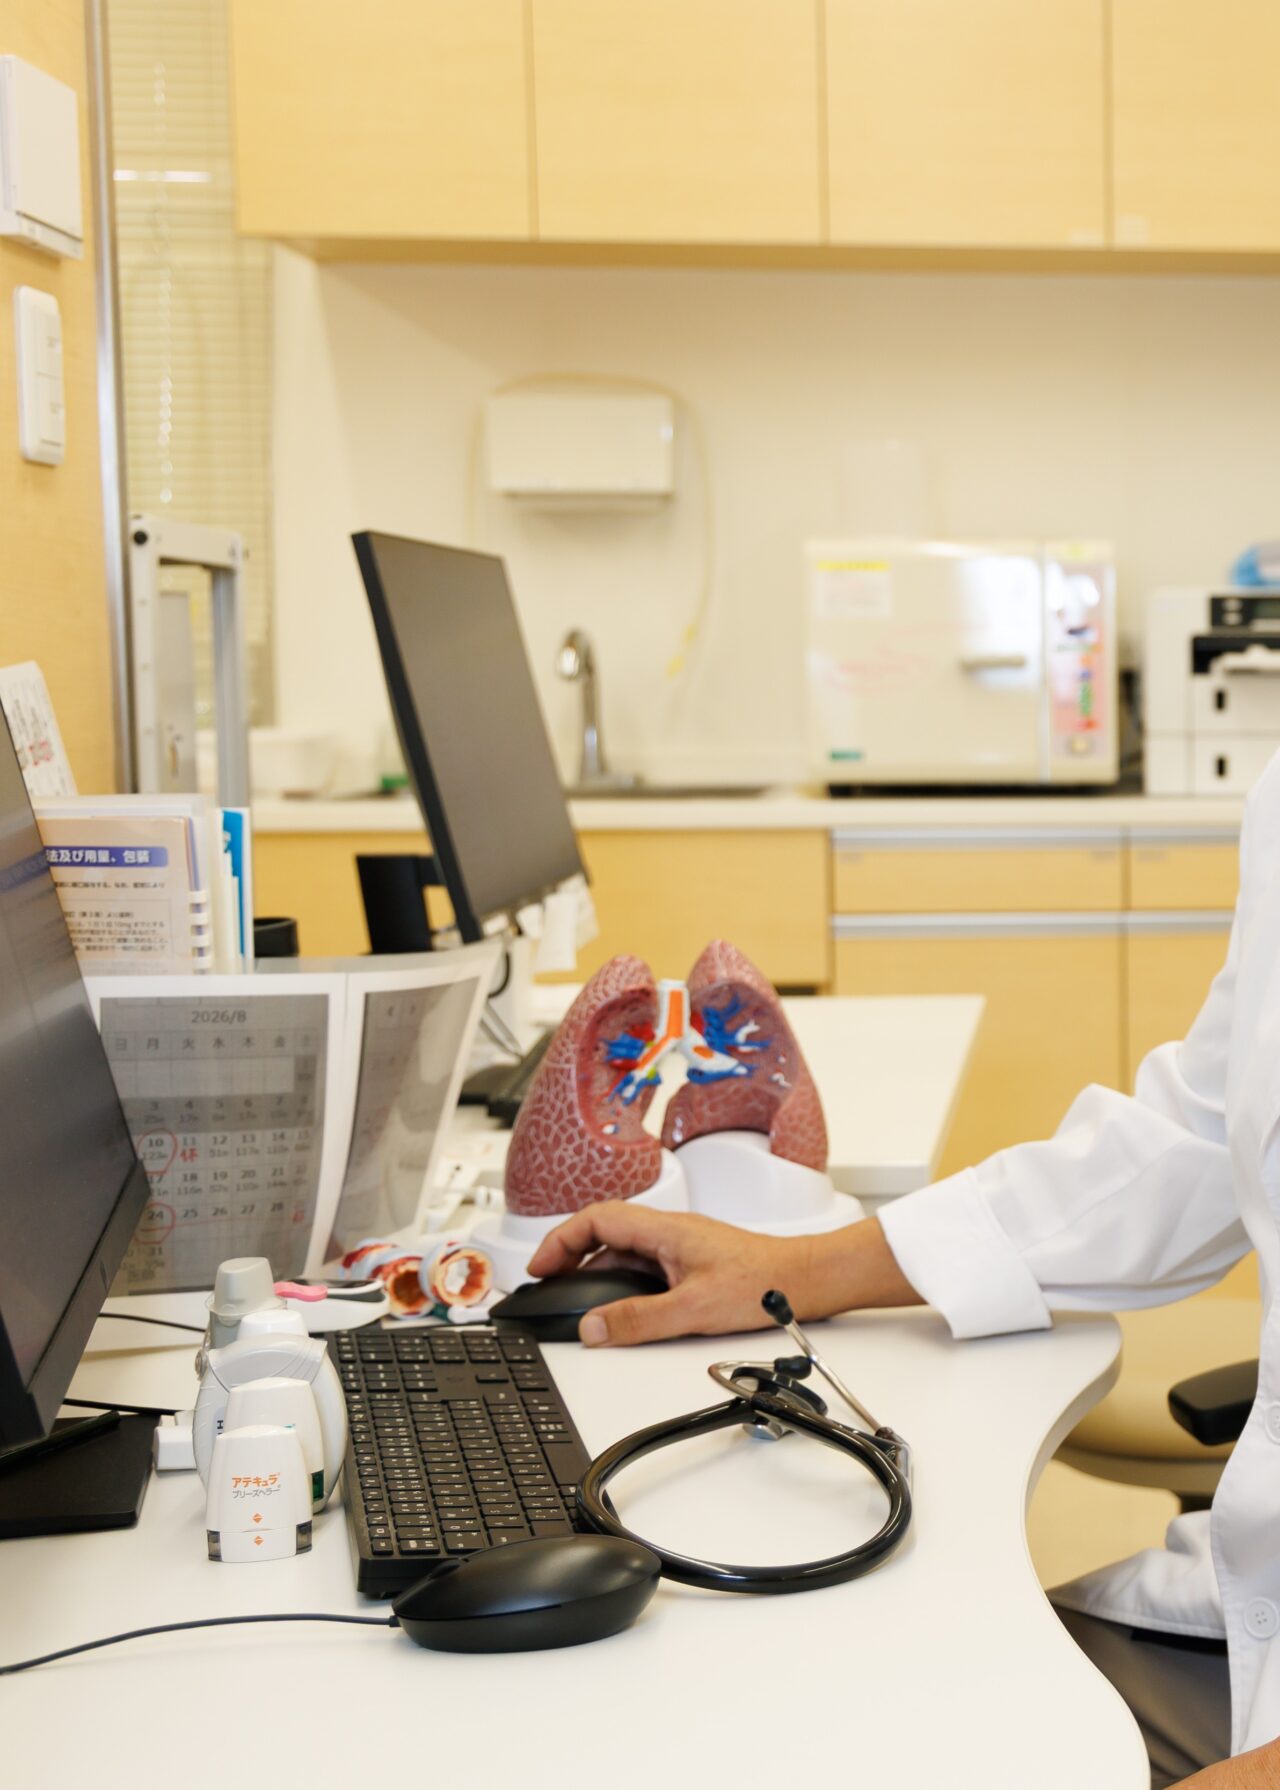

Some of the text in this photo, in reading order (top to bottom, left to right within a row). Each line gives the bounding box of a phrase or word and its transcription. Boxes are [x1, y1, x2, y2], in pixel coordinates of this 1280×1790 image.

[191, 1010, 247, 1025] 2026/8
[147, 1037, 160, 1051] 月
[181, 1037, 195, 1051] 火
[148, 1138, 164, 1148] 10
[212, 1135, 228, 1145] 12
[148, 1210, 164, 1220] 24
[231, 1474, 278, 1488] アテキュラ
